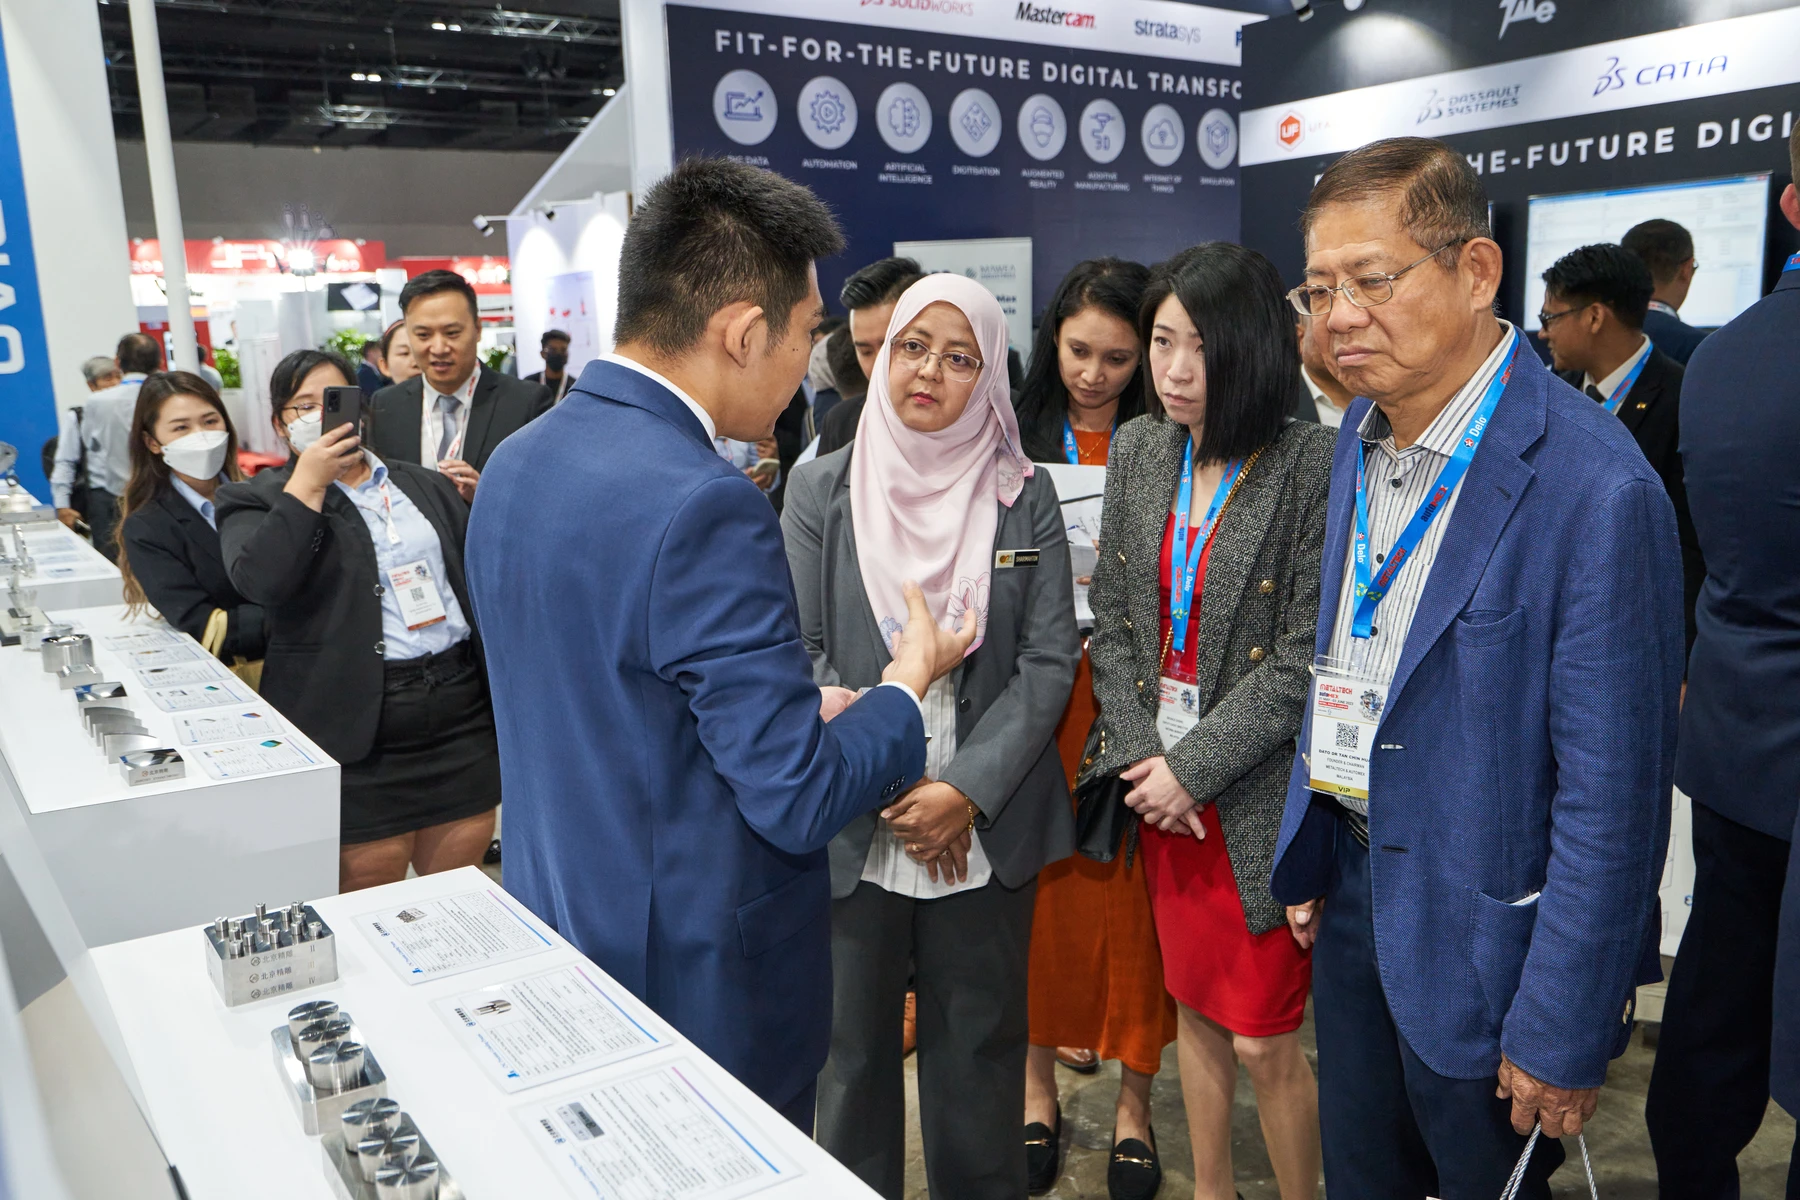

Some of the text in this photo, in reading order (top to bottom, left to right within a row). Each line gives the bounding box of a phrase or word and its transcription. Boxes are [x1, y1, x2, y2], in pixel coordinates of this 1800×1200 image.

[1134, 18, 1201, 45] stratasys
[715, 29, 1030, 80] FIT-FOR-THE-FUTURE
[1042, 61, 1138, 90] DIGITAL
[802, 158, 858, 170] AUTOMATION
[884, 162, 926, 173] ARTIFICIAL
[878, 174, 932, 185] INTELLIGENCE
[1021, 169, 1064, 180] AUGMENTED
[1029, 180, 1057, 189] REALITY
[1075, 182, 1130, 192] MANUFACTURING
[1469, 414, 1487, 437] Delo
[1357, 543, 1365, 565] Delo
[1184, 576, 1193, 592] Delo
[1320, 684, 1353, 695] METALTECH
